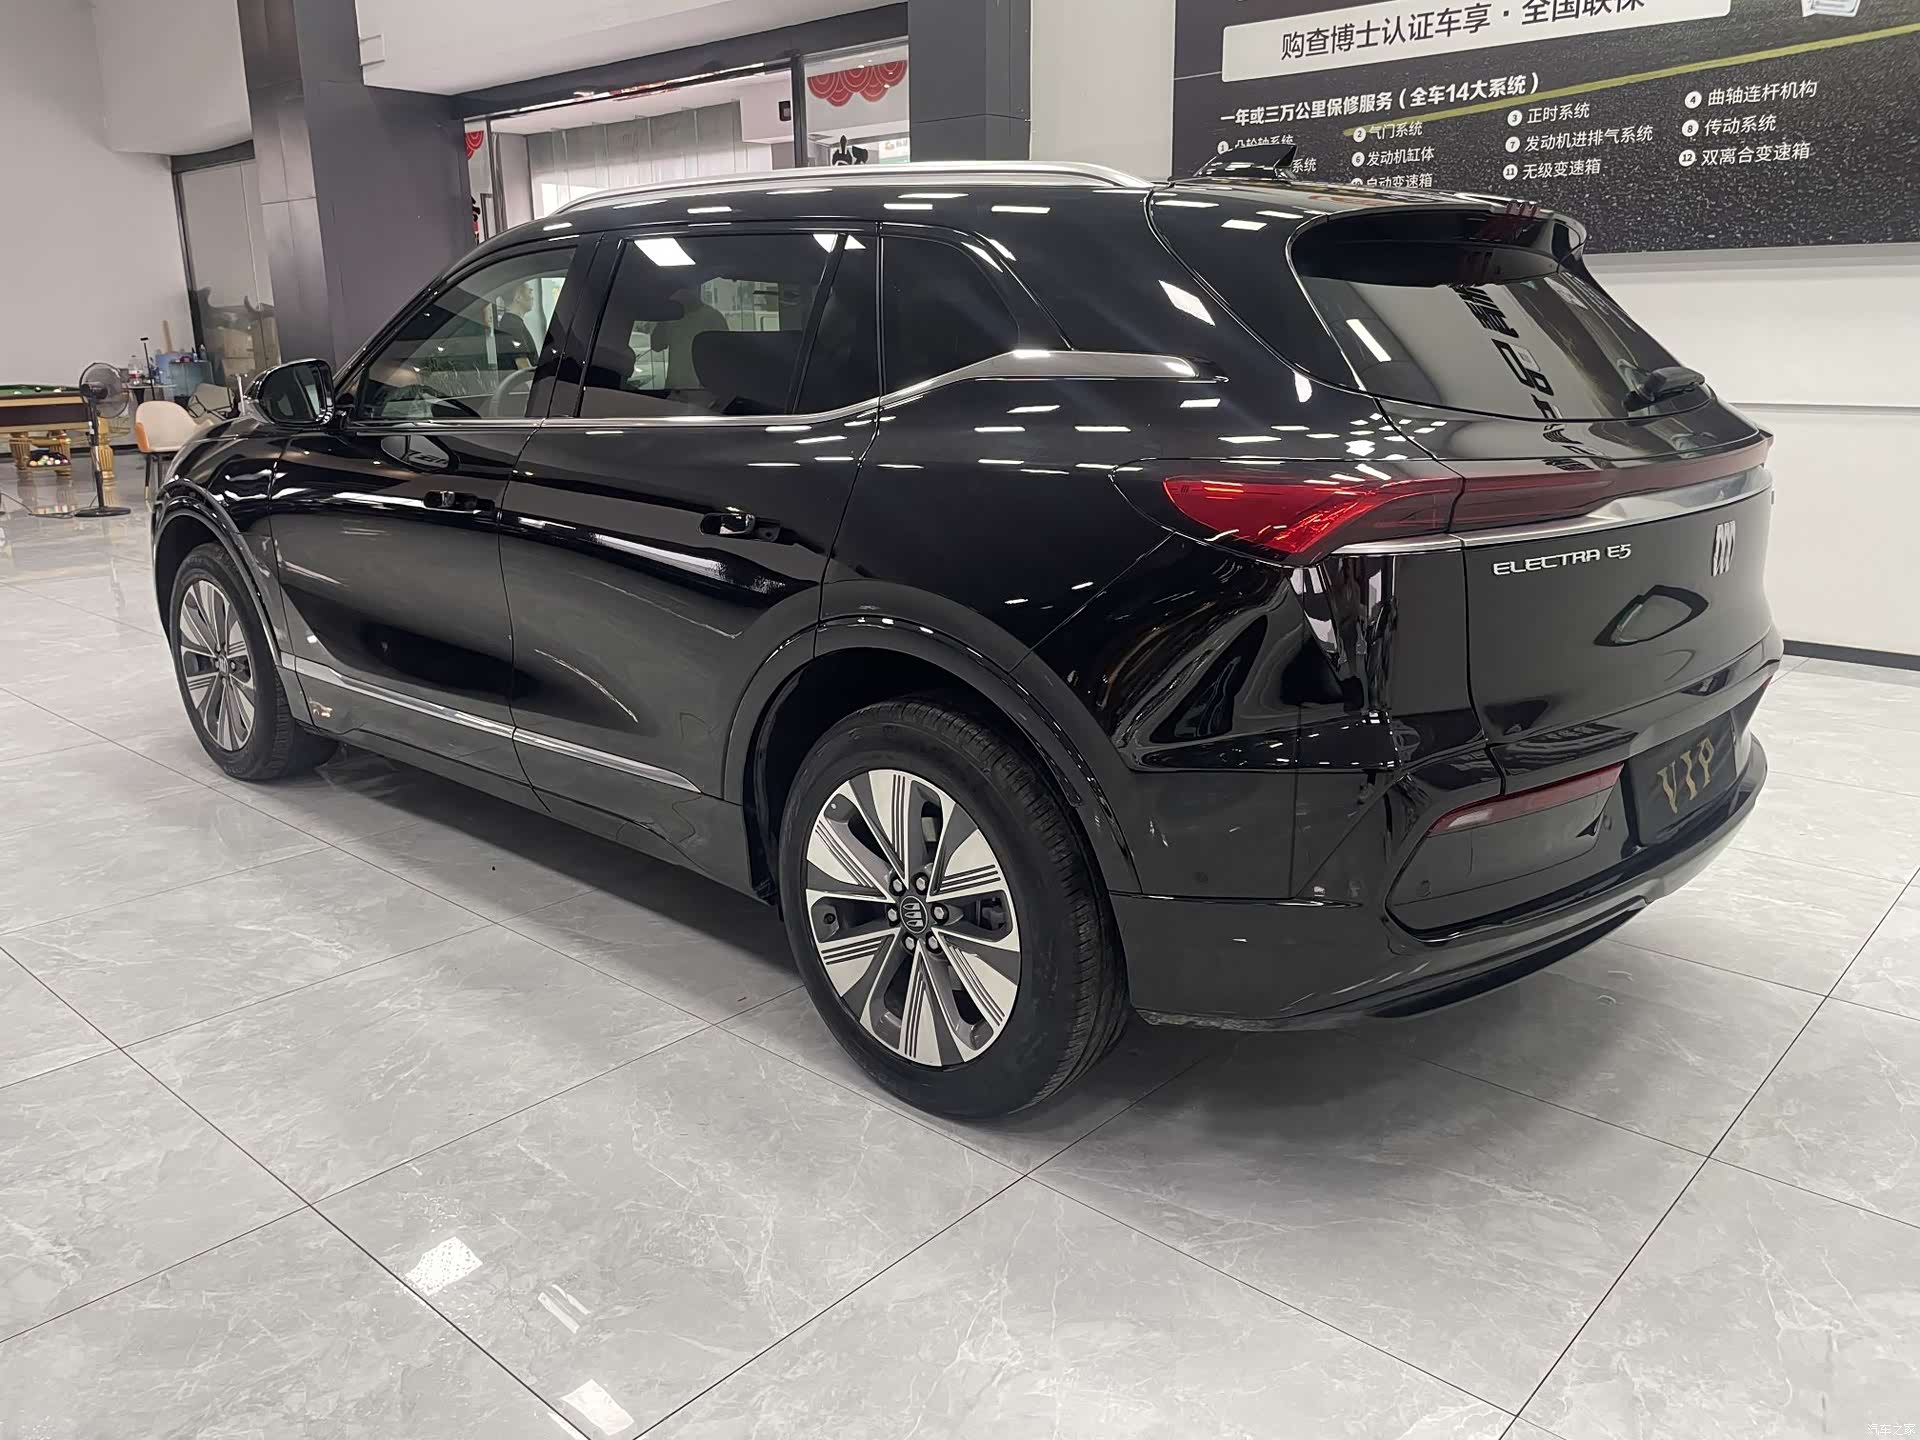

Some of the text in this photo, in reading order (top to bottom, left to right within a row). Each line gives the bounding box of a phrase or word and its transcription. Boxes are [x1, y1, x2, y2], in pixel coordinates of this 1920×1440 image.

[1708, 79, 1818, 107] 曲轴连杆机构
[1527, 102, 1590, 124] 正时系统
[1368, 121, 1423, 140] 气门系统
[1704, 114, 1777, 136] 传动系统
[1524, 125, 1654, 152] 发动机进排气系统
[1366, 146, 1435, 167] 发动机缸体
[1701, 142, 1811, 167] 双离合变速箱
[1522, 158, 1602, 180] 无级变速箱
[1493, 543, 1632, 576] ELECTRA E5
[1656, 736, 1715, 814] VIP
